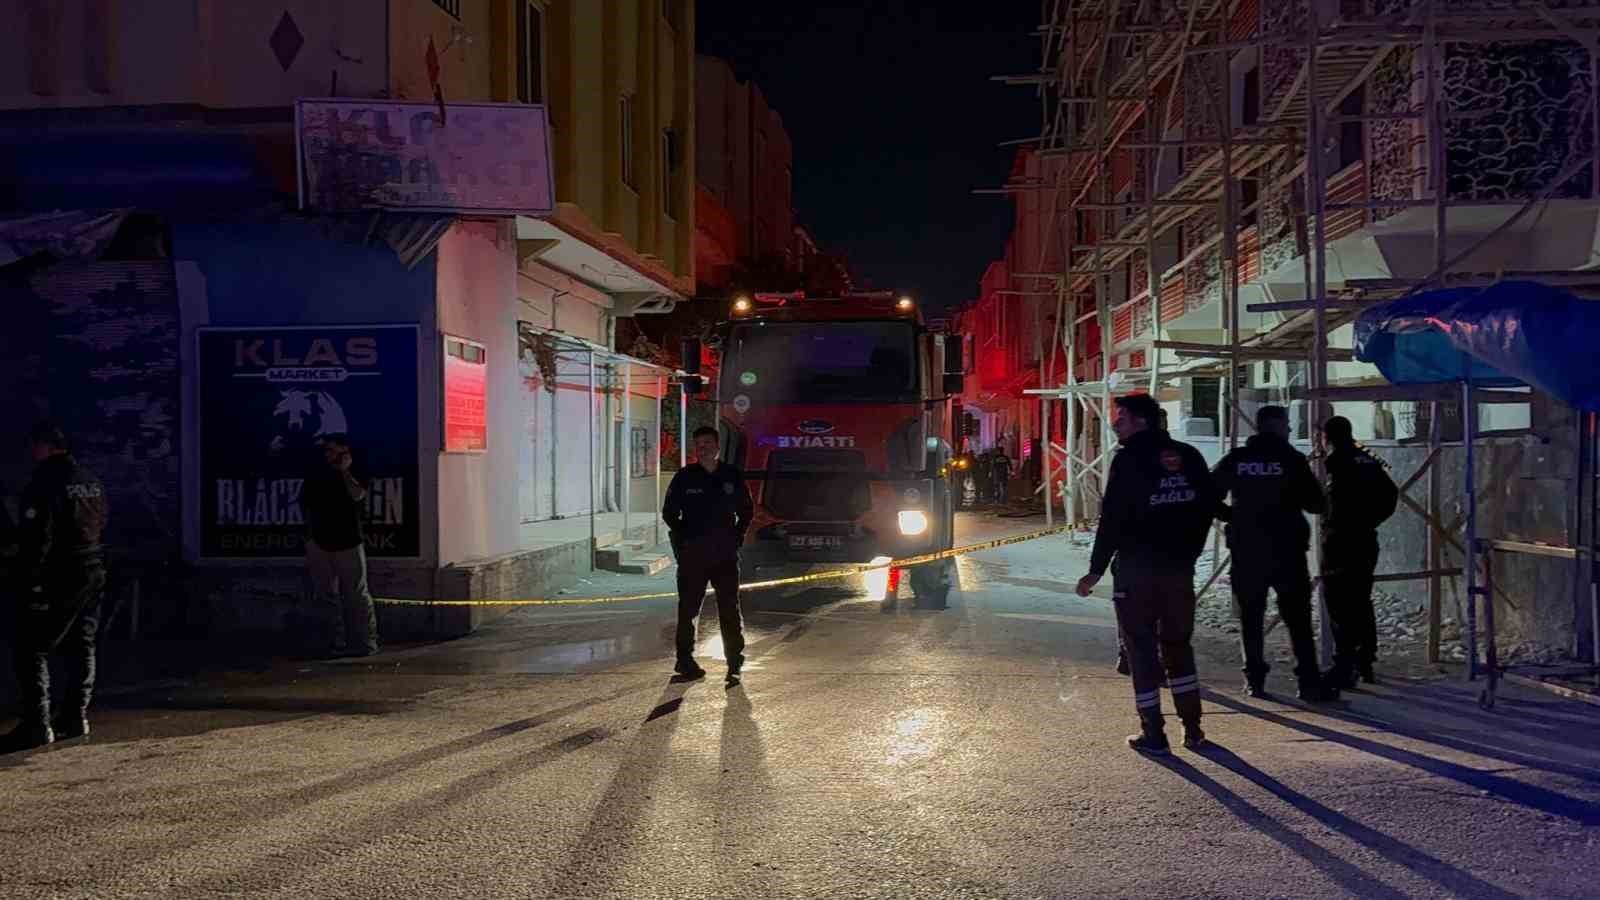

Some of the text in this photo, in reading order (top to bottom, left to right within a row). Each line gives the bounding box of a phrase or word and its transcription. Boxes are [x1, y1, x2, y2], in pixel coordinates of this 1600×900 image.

[232, 337, 379, 367] KLAS
[269, 369, 343, 380] MARKET
[215, 477, 306, 527] BLACK
